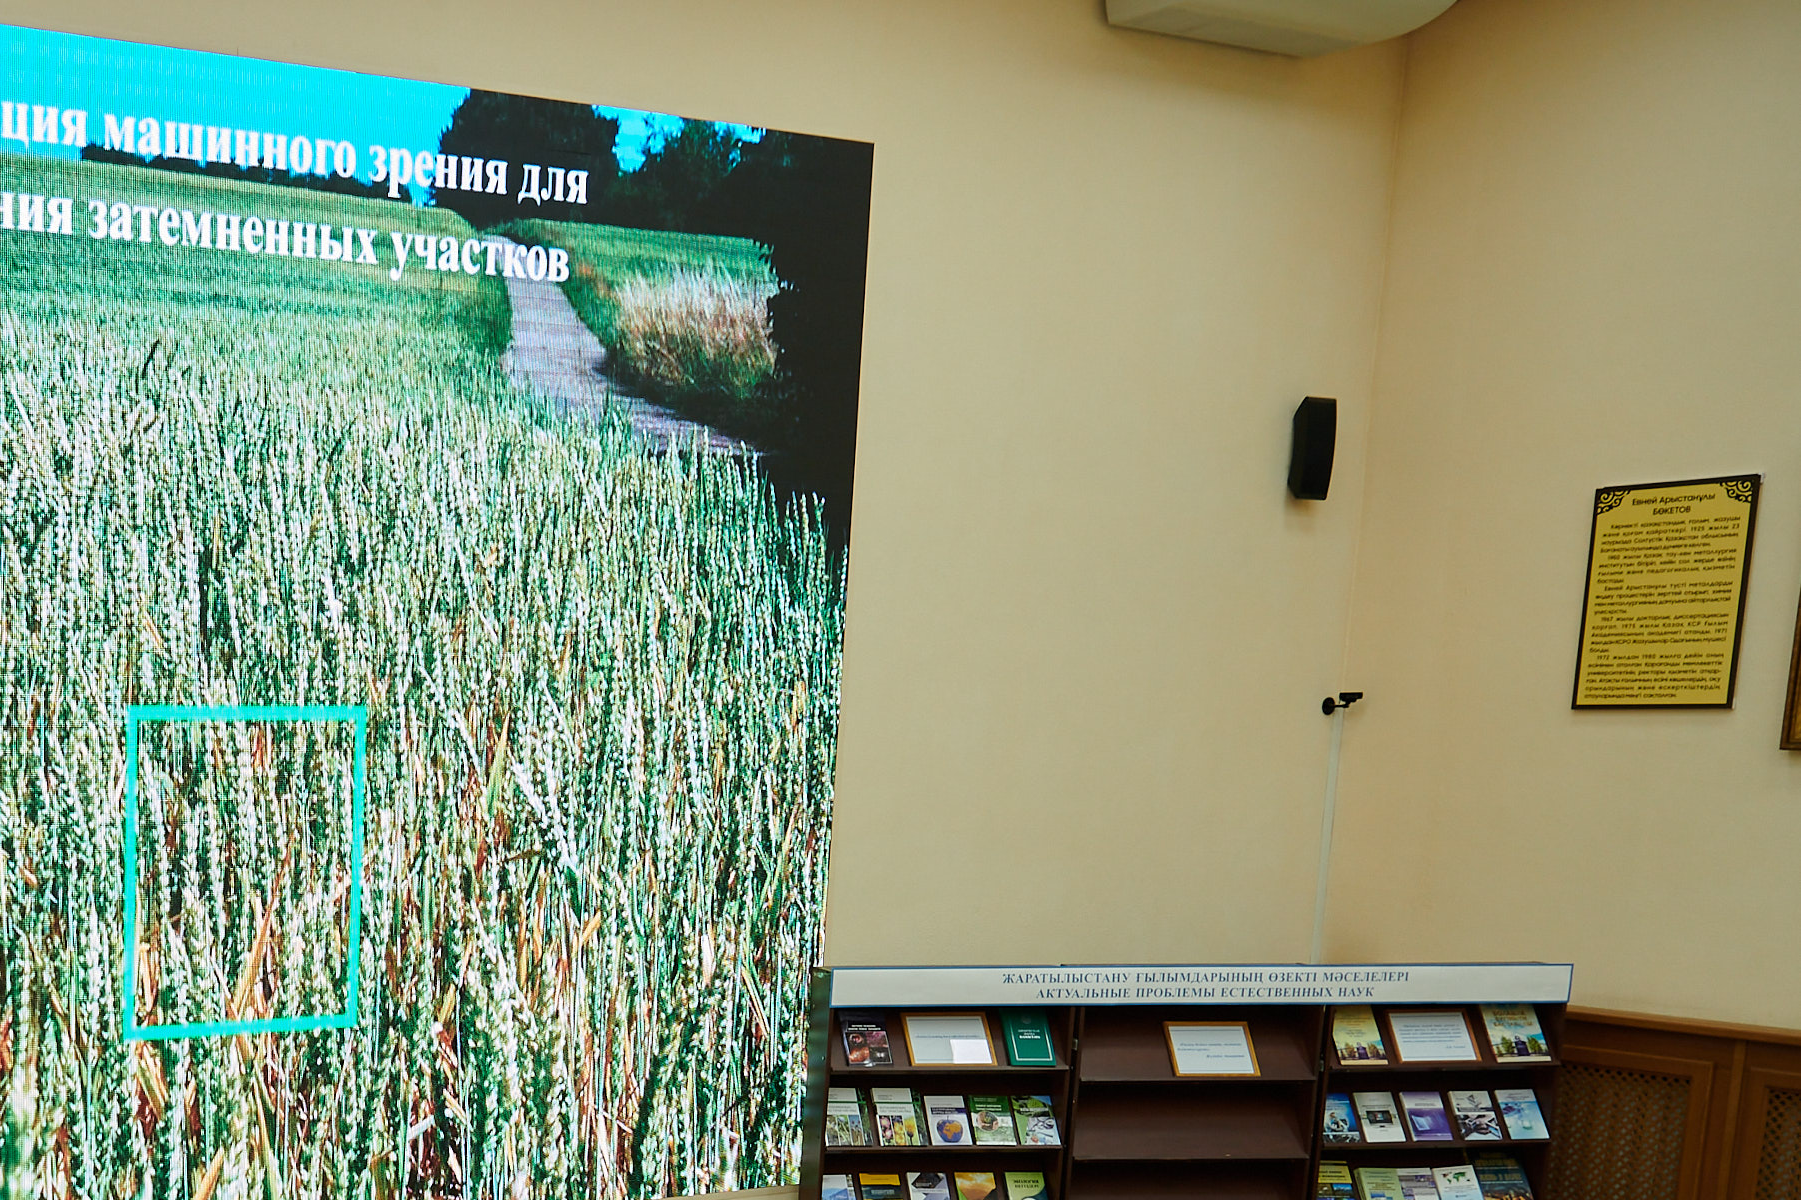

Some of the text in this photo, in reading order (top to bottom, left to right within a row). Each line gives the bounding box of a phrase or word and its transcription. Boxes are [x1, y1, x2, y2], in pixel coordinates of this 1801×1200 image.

[104, 114, 356, 178] машинного
[368, 145, 508, 198] зрения
[517, 164, 589, 206] для
[88, 199, 378, 265] затемненных
[389, 232, 570, 282] участков
[1652, 505, 1691, 515] БӨКЕТОВ
[1002, 972, 1131, 984] ЖАРАТЫЛЫСТАНУ
[1268, 972, 1317, 982] ӨЗЕКТІ
[1322, 971, 1409, 982] МӘСЕЛЕЛЕРІ
[1036, 986, 1375, 998] АКТУАЛЬНЫЕ ПРОБЛЕМЫ ЕСТЕСТВЕННЫХ НАУК
